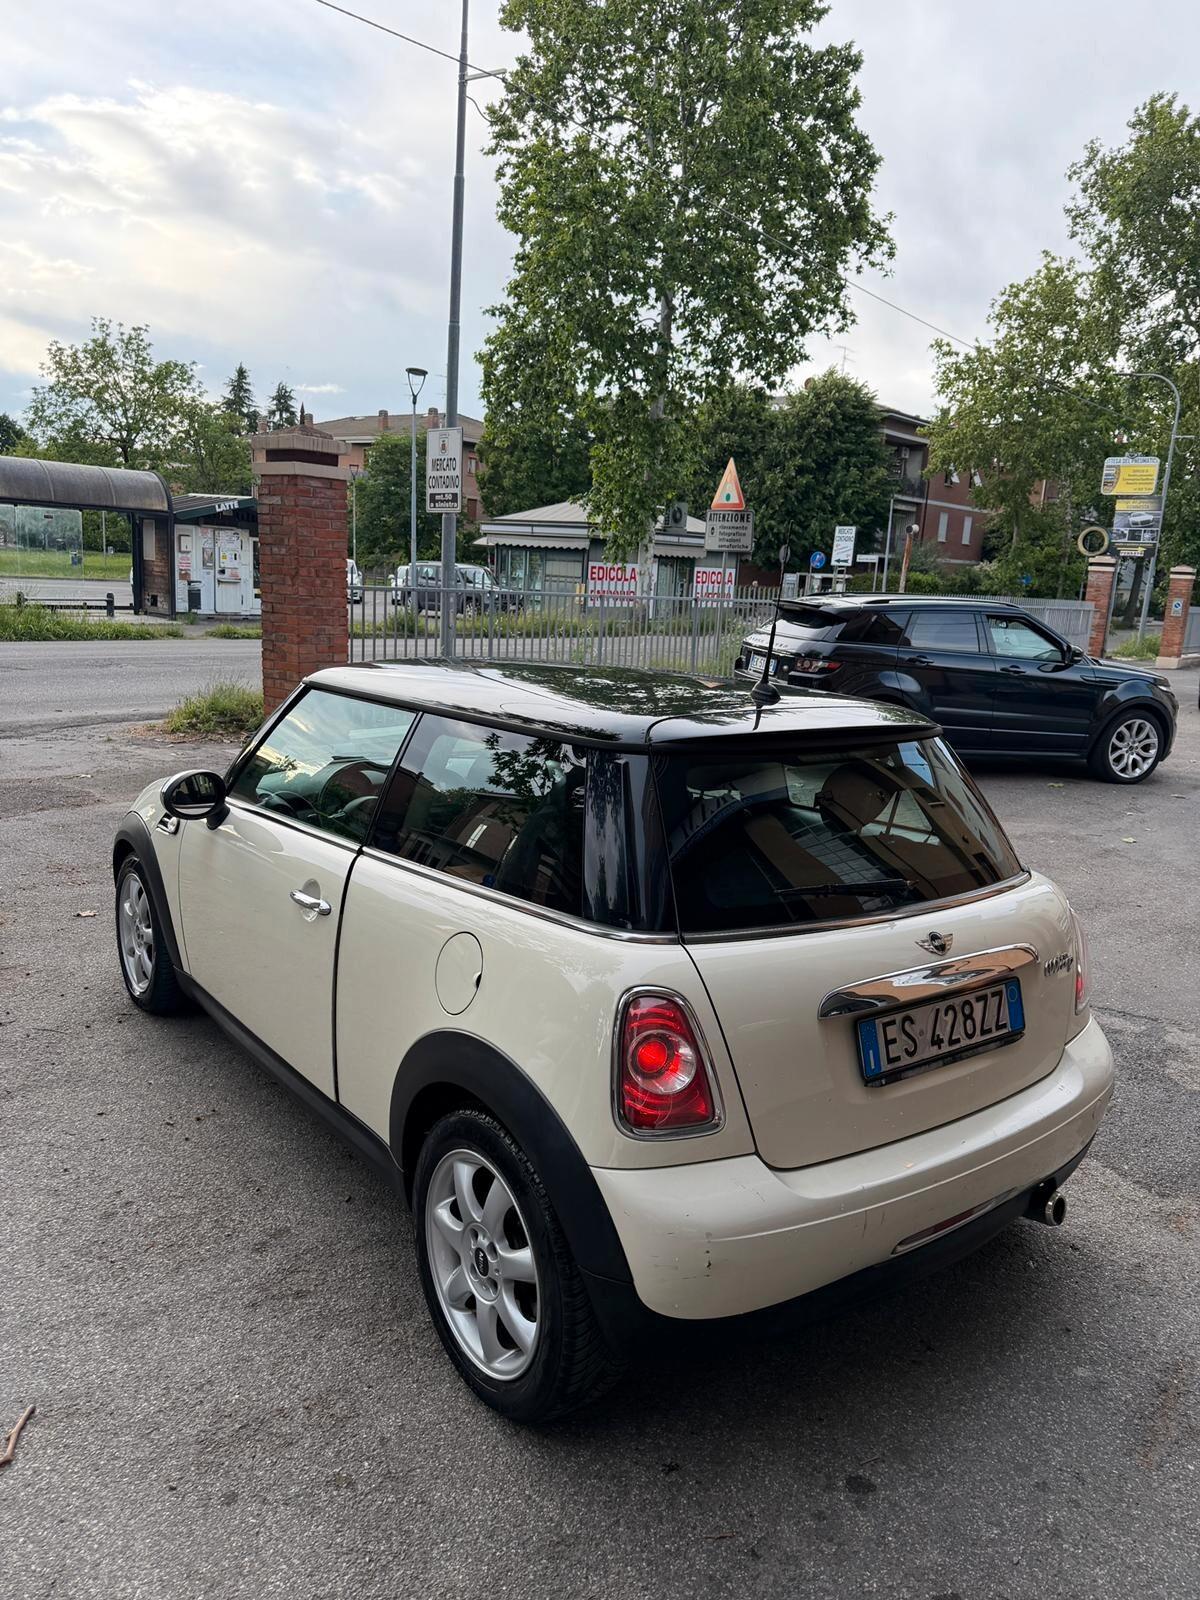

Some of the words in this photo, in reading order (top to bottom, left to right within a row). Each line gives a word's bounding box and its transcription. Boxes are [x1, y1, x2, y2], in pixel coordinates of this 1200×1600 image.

[431, 457, 457, 471] MERCATO
[429, 475, 459, 489] CONTADINO
[215, 500, 239, 512] LATTE
[709, 512, 751, 523] ATTENZIONE
[590, 566, 637, 582] EDICOLA
[695, 570, 733, 585] EDICOA
[881, 1014, 918, 1065] ES
[930, 989, 1008, 1050] 428ZZ
